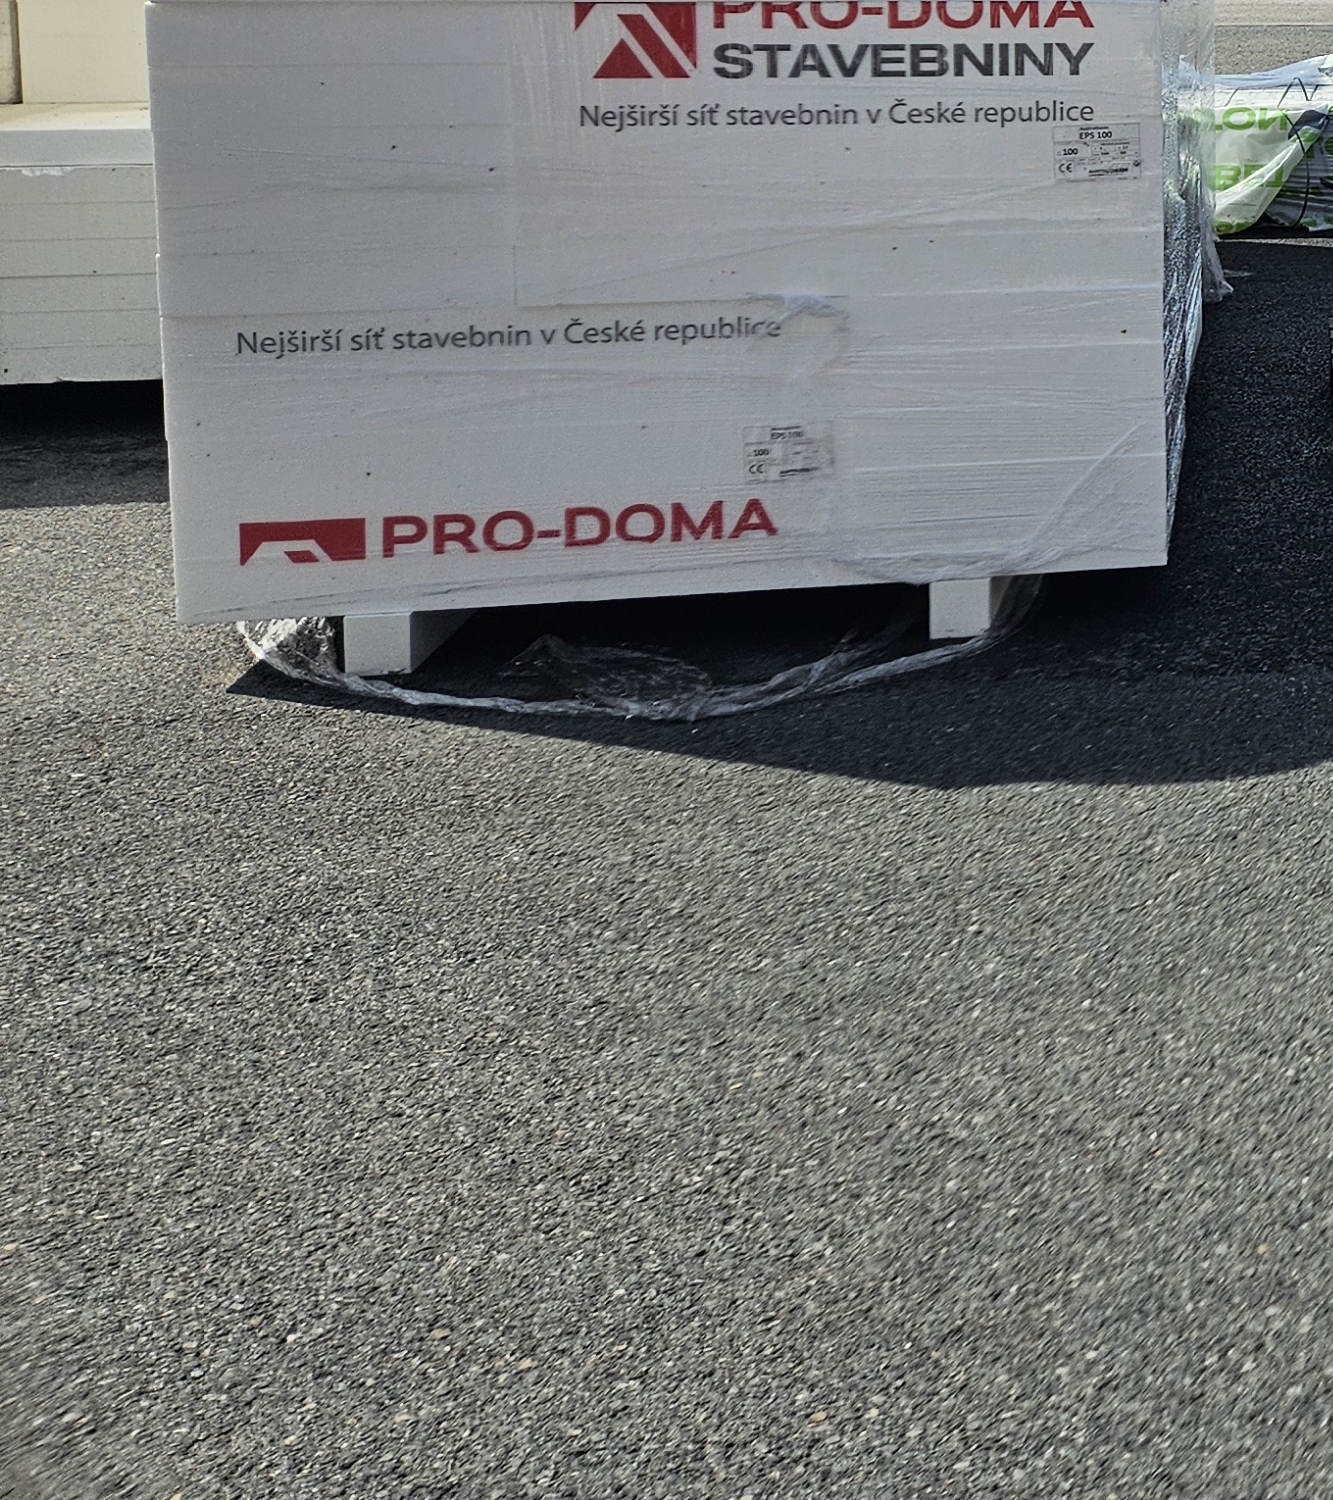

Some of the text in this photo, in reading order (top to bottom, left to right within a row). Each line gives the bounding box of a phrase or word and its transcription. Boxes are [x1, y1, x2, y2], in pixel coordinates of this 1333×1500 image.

[712, 0, 1095, 30] PRO-DOMA
[713, 42, 1094, 79] STAVEBNINY
[579, 98, 1094, 132] Nejširší síť stavebnin v České republice
[1097, 131, 1112, 139] 100
[236, 315, 782, 360] Nejširší síť stavebnin v České republice
[381, 498, 779, 559] PRO-DOMA
